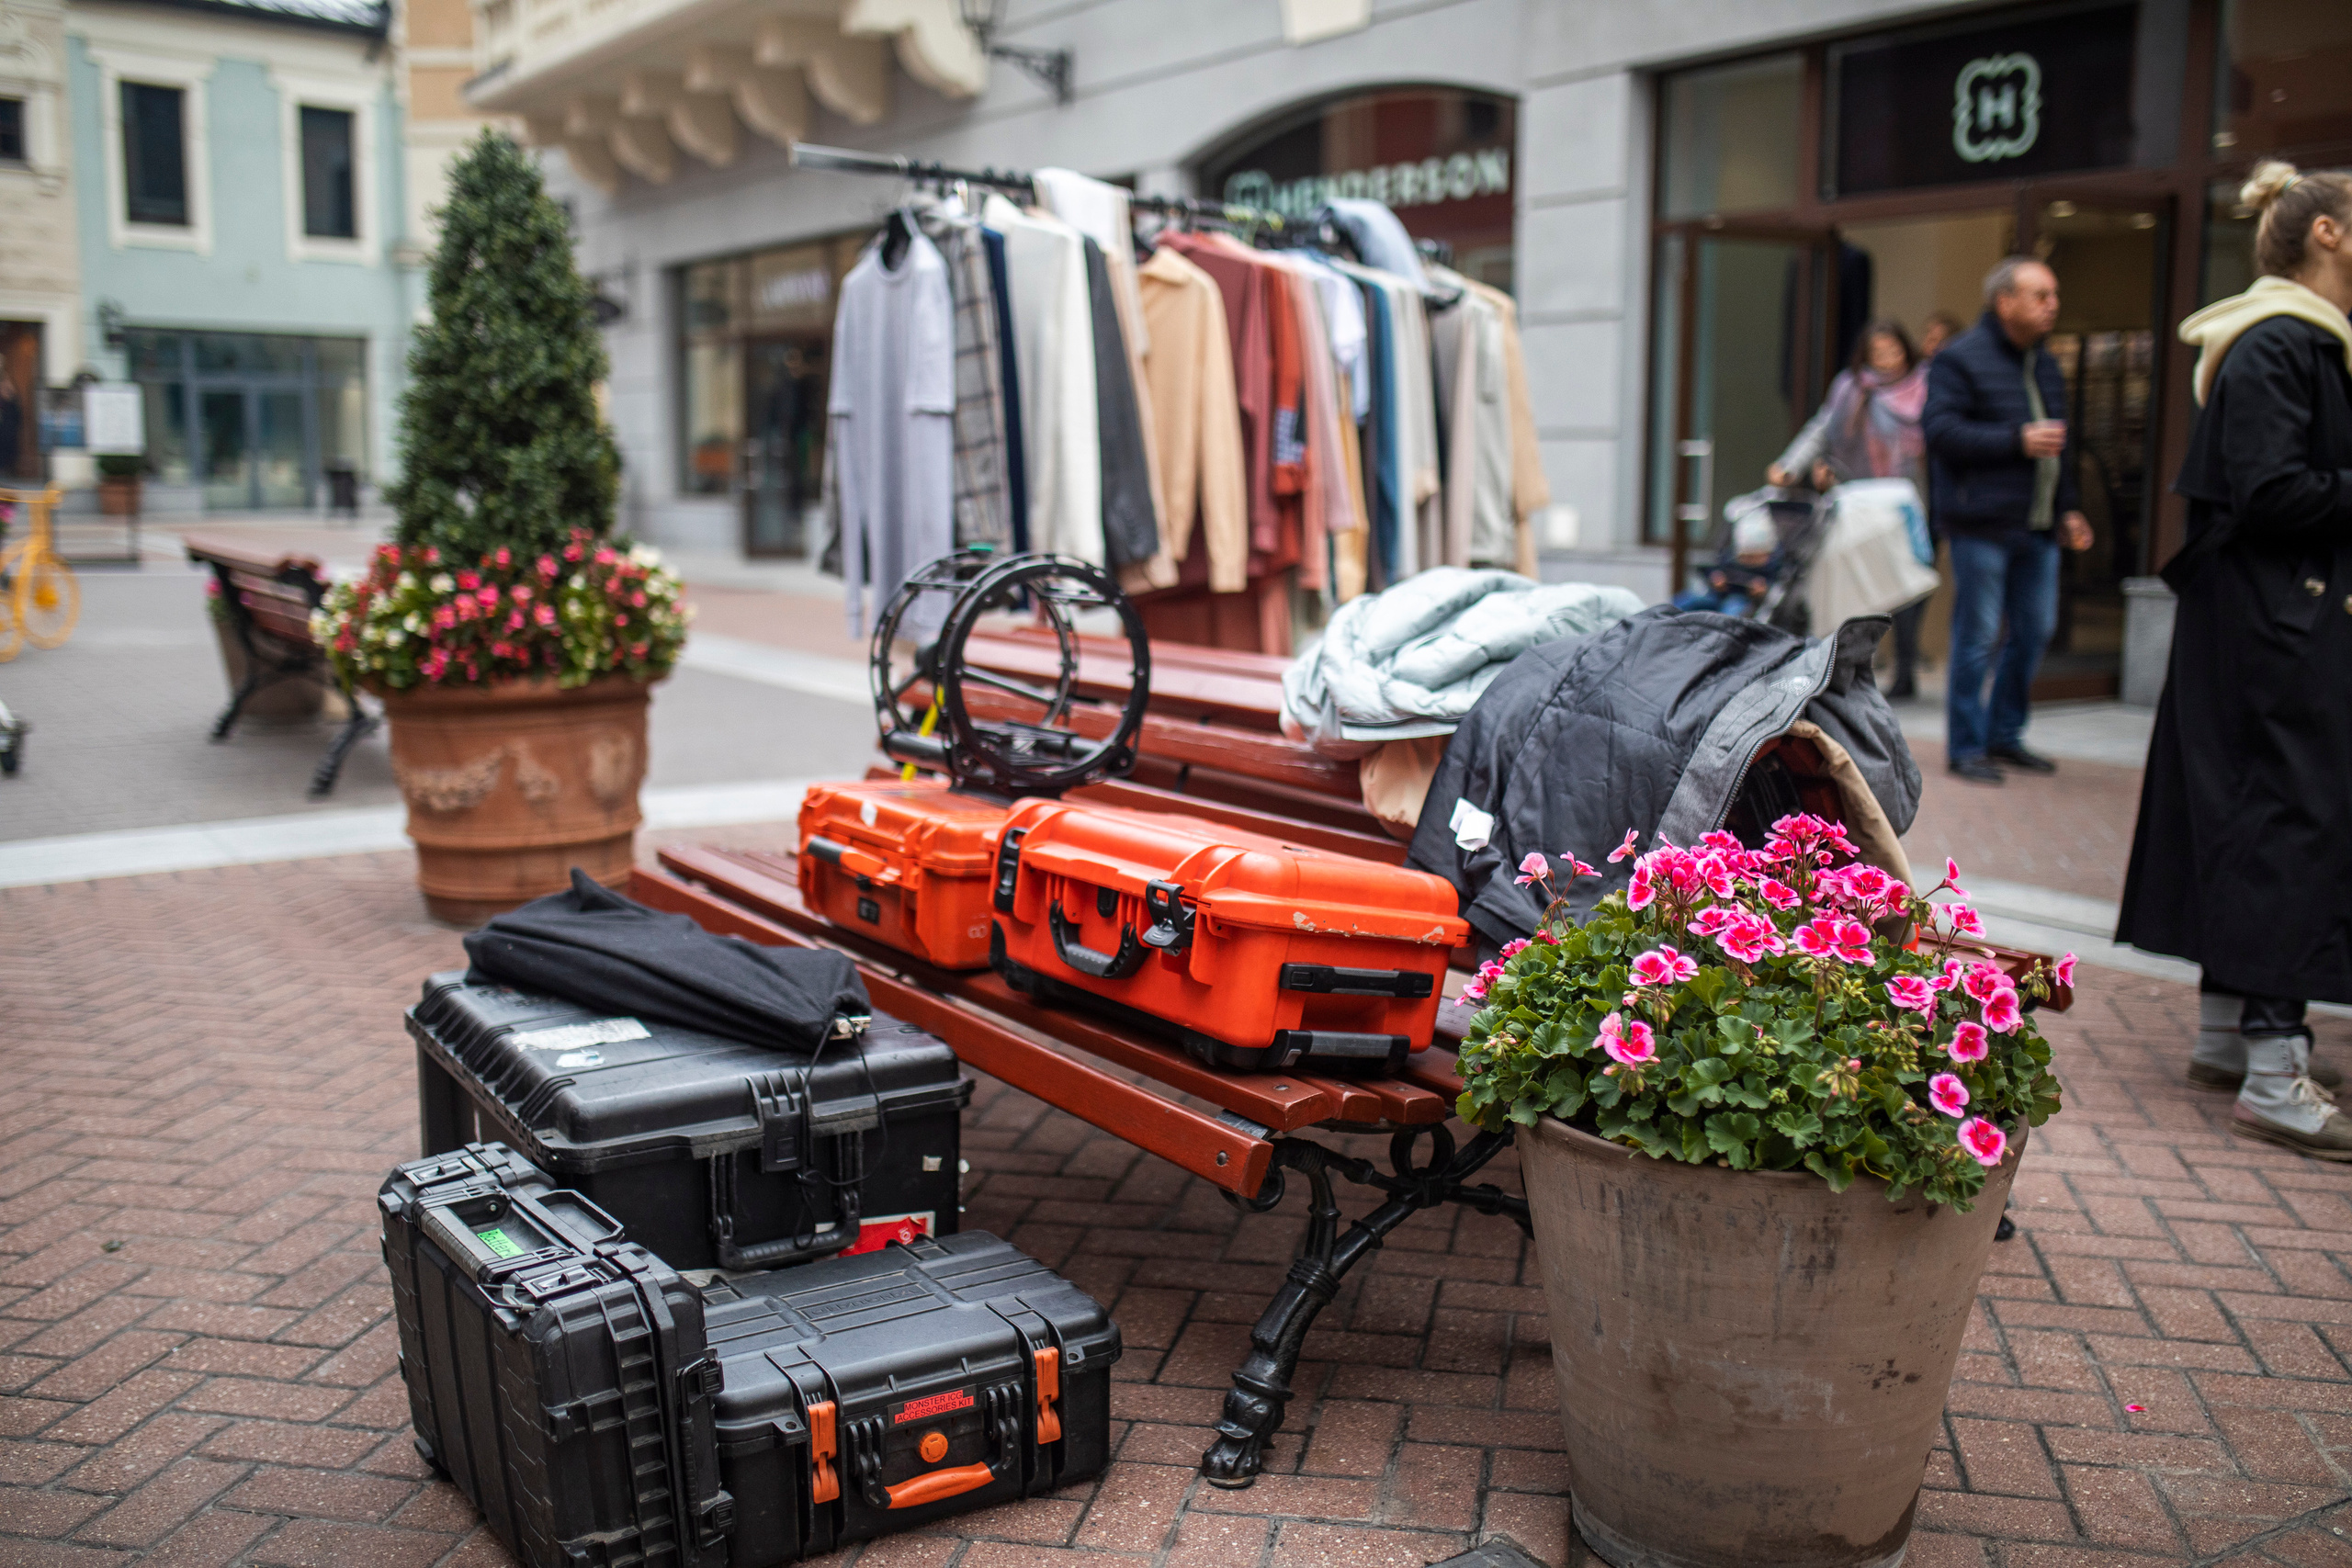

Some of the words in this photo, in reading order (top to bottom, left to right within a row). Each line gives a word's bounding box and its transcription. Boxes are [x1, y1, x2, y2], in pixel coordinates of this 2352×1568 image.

[897, 1401, 956, 1422] ACCESSORIES
[958, 1397, 972, 1407] KIT
[904, 1395, 945, 1412] MONSTER
[947, 1392, 963, 1402] ICG
